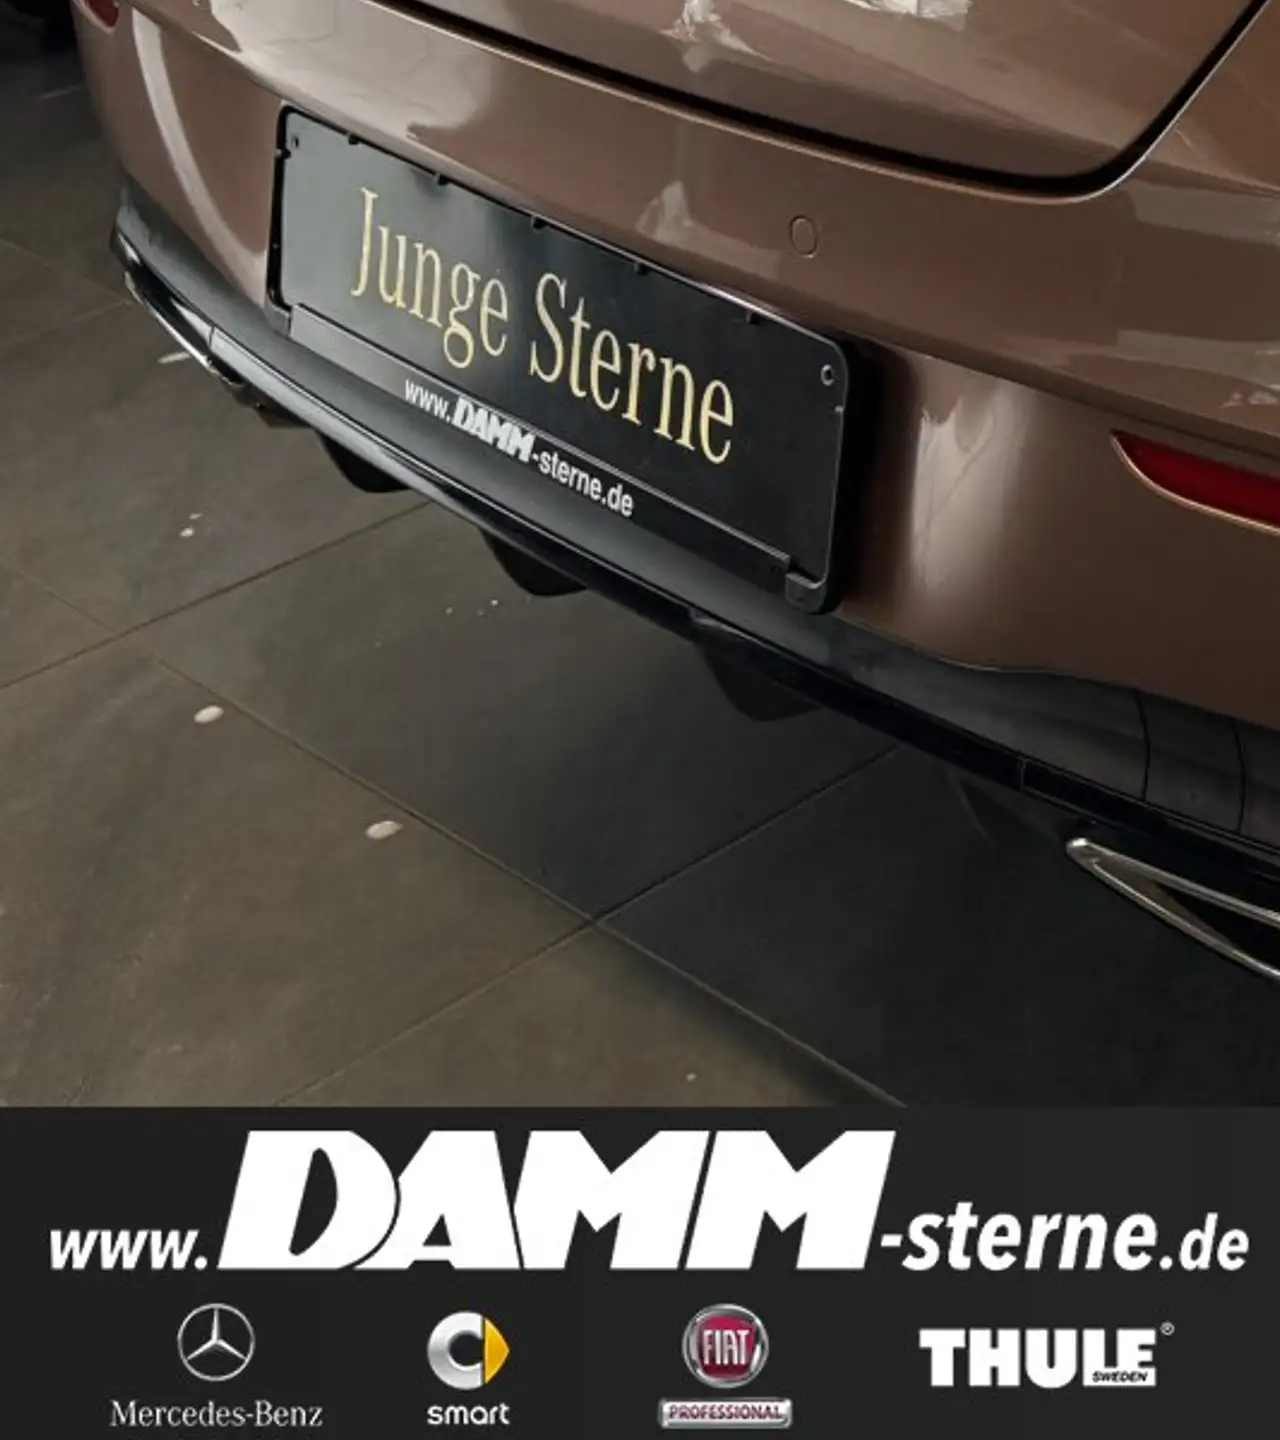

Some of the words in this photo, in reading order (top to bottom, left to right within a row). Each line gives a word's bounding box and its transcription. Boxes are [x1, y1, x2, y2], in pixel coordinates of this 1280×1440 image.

[350, 186, 509, 369] Junge
[528, 272, 734, 465] Sterne
[404, 378, 635, 518] www.DAMM-sterne.de
